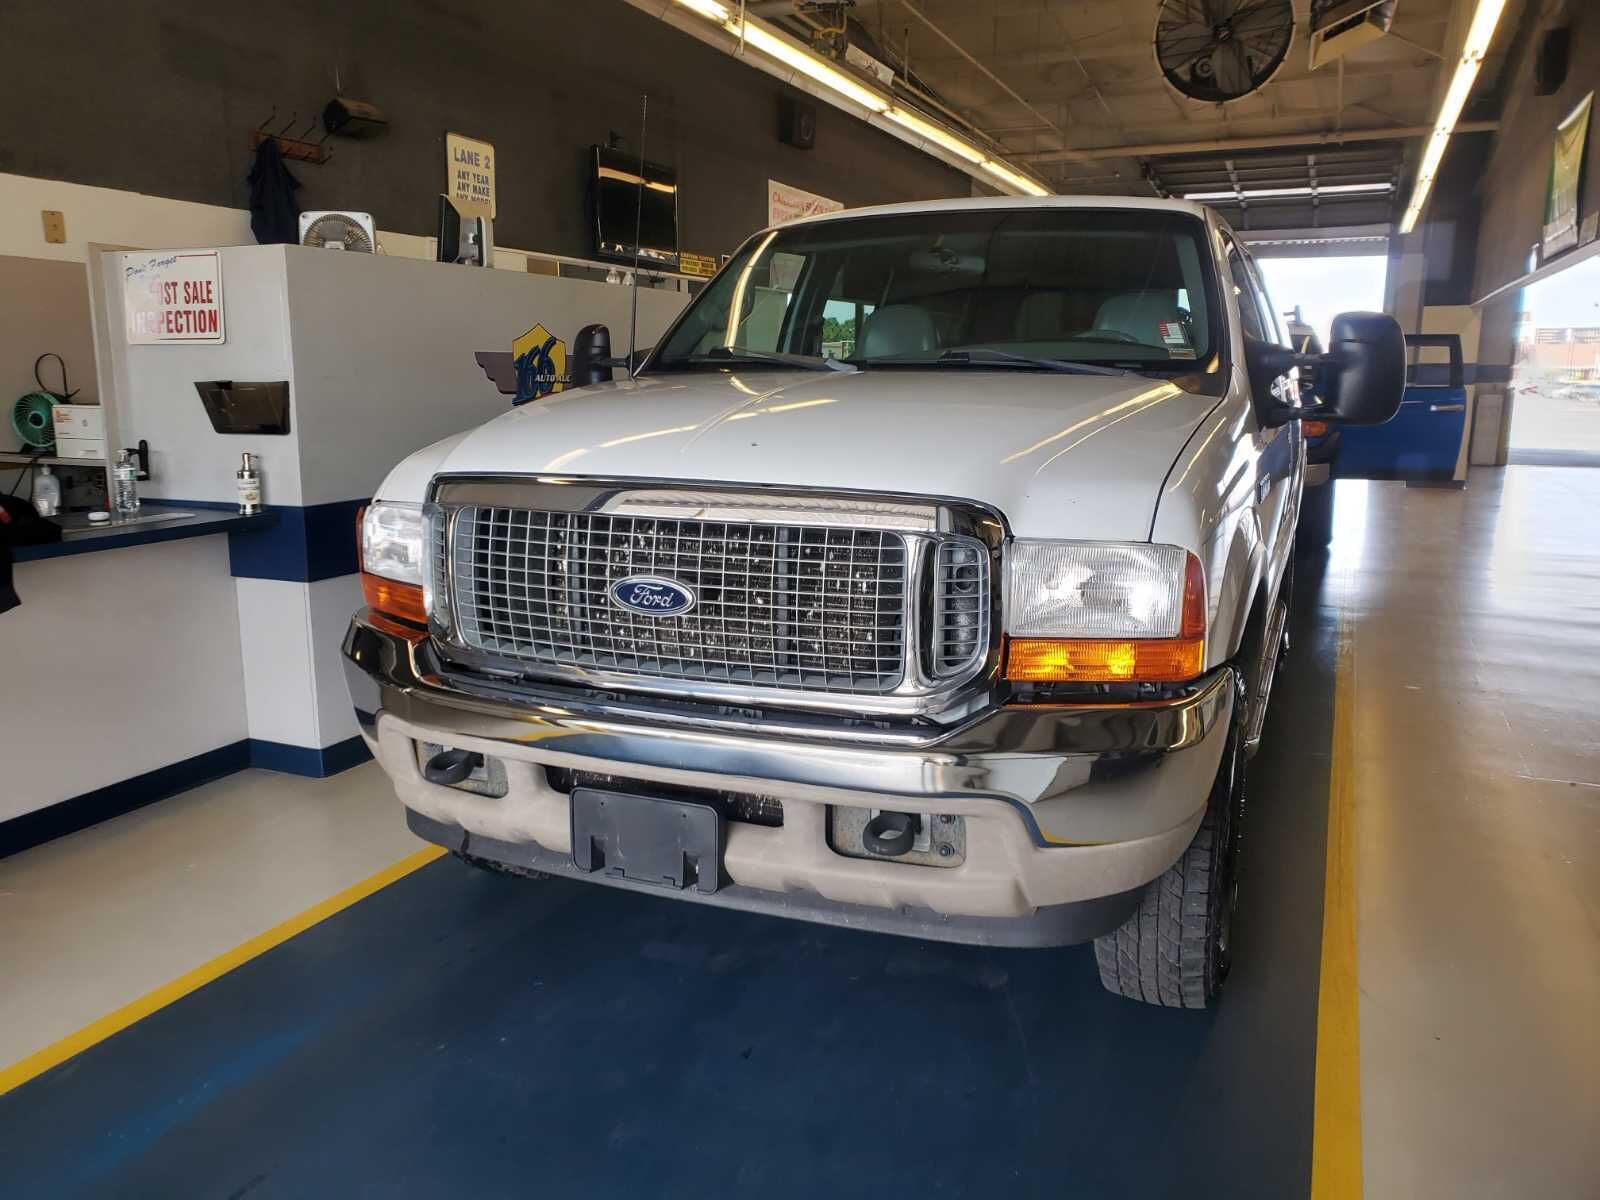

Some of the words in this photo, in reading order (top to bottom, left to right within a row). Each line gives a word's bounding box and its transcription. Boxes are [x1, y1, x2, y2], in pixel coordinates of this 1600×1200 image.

[453, 147, 481, 168] LANE
[484, 154, 491, 170] 2
[457, 169, 470, 181] ANY
[472, 172, 489, 186] YEAR
[457, 181, 470, 194] ANY
[472, 183, 490, 197] MAKE
[183, 280, 213, 304] SALE
[534, 374, 556, 383] AUTO
[630, 584, 675, 608] Ford
